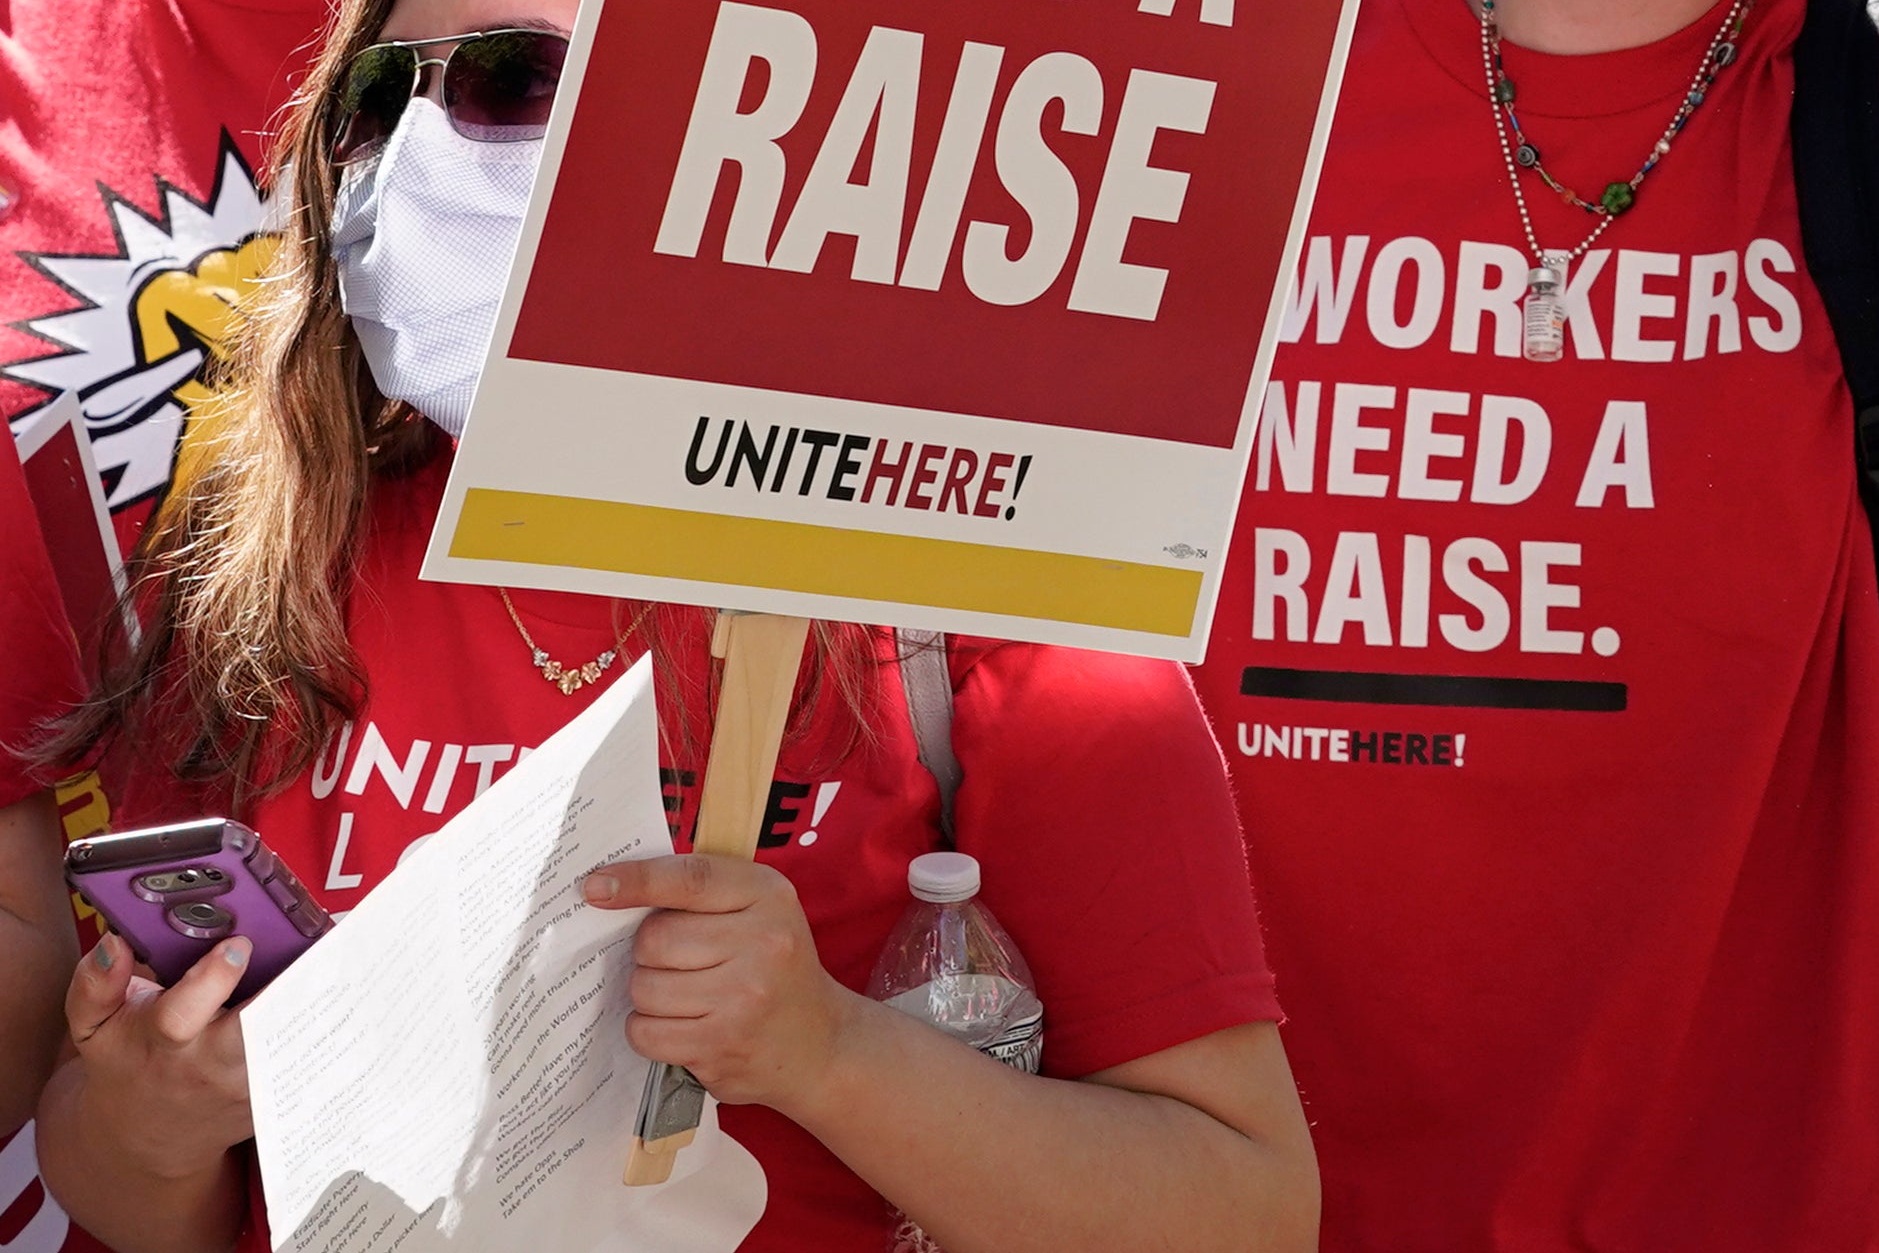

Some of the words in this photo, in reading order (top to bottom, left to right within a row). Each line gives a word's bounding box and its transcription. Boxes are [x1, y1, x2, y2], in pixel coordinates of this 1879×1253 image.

[652, 0, 1219, 322] RAISE
[1277, 234, 1802, 363] WORKERS
[683, 415, 1034, 522] UNITEHERE!
[1254, 380, 1553, 506] NEED
[1575, 399, 1655, 510] A
[1250, 526, 1621, 657] RAISE.
[1236, 722, 1467, 769] UNITEHERE!
[608, 843, 632, 861] have
[635, 838, 641, 846] a
[536, 908, 572, 937] fighting
[490, 1044, 513, 1075] Gonna
[512, 1018, 528, 1044] need
[528, 995, 546, 1021] more
[547, 977, 570, 996] than
[578, 955, 596, 972] few
[492, 1011, 509, 1037] years
[509, 974, 536, 1010] working
[504, 1012, 521, 1038] make
[522, 990, 536, 1012] rent
[497, 1063, 527, 1100] Workers
[526, 1045, 538, 1063] run
[537, 1029, 550, 1046] the
[550, 1001, 579, 1029] World
[542, 1053, 563, 1076] Have
[564, 1040, 578, 1054] my
[540, 1082, 552, 1099] like
[554, 1065, 570, 1084] you
[500, 1192, 514, 1207] We
[514, 1172, 533, 1192] hate
[502, 1199, 521, 1219] Take
[522, 1184, 536, 1200] em
[537, 1174, 547, 1185] to
[548, 1159, 562, 1175] the
[563, 1138, 585, 1161] Shop
[292, 1199, 332, 1240] Eradicate
[296, 1230, 317, 1252] Start
[318, 1206, 338, 1231] Right
[340, 1185, 359, 1207] Here
[372, 1214, 395, 1242] Dollar
[394, 1218, 418, 1249] picket
